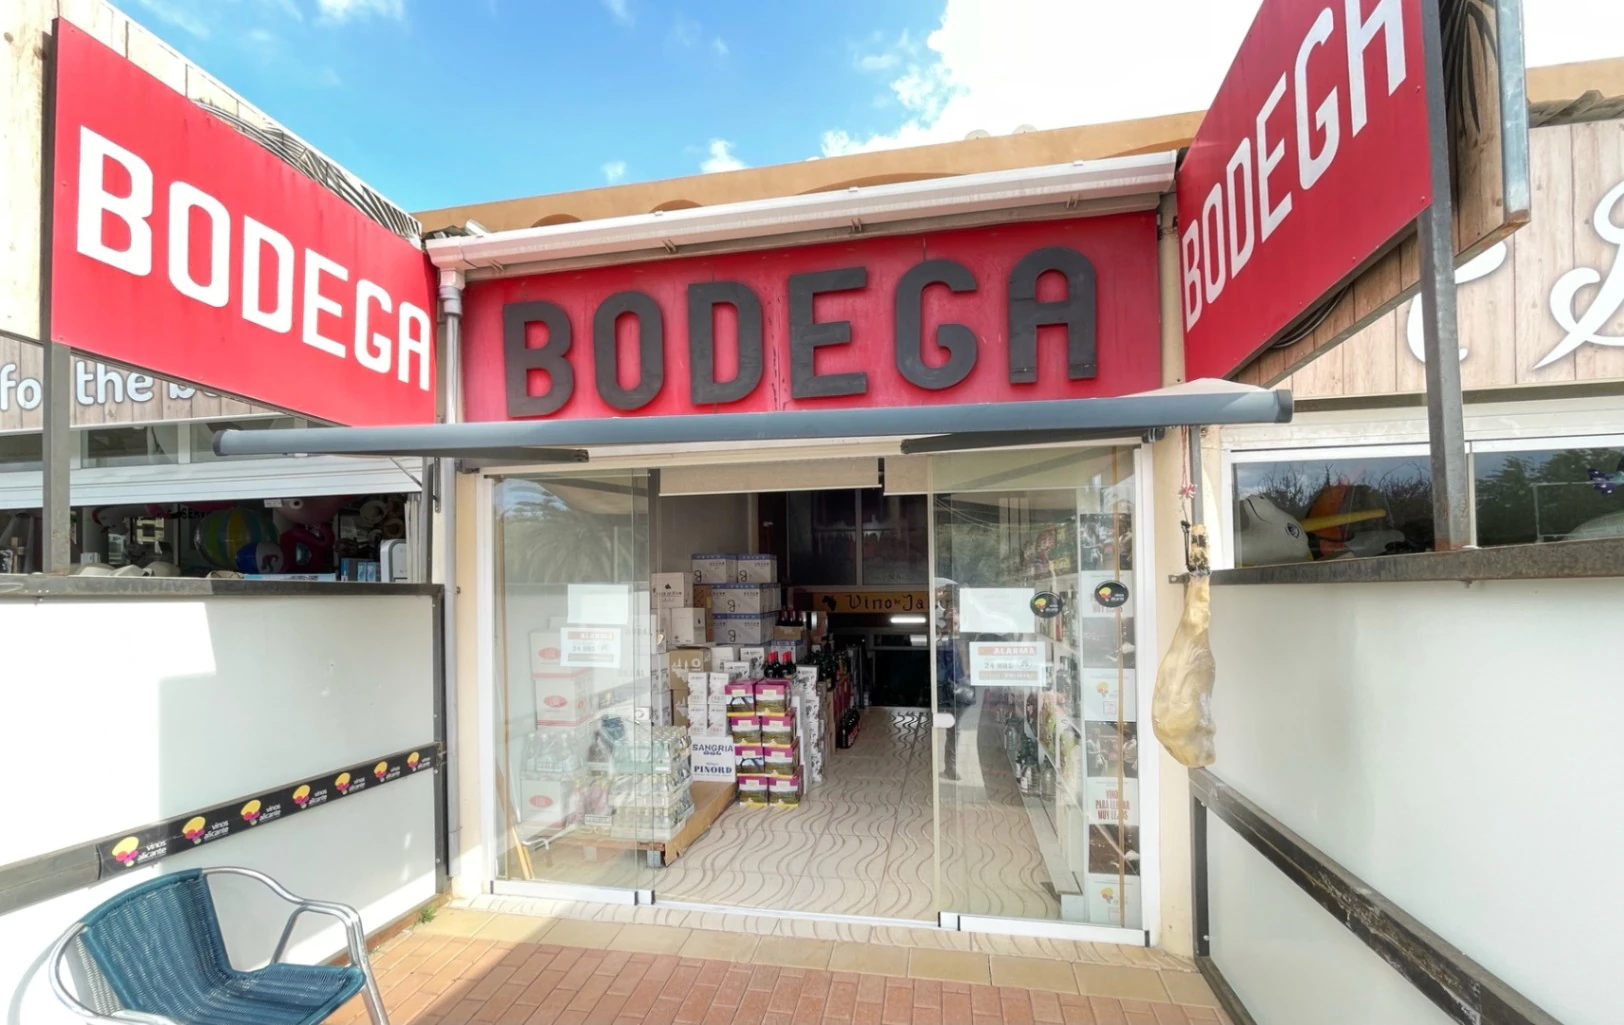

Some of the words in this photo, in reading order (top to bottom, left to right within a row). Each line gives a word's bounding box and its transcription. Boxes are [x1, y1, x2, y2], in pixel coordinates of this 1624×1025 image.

[76, 124, 430, 391] BODEGA
[502, 246, 1098, 418] BODEGA
[75, 361, 154, 406] the
[902, 593, 930, 612] Ja
[993, 647, 1036, 655] ALARMA
[692, 743, 734, 752] SANGRIA
[694, 765, 732, 774] PINORD
[314, 789, 328, 797] vinos
[265, 803, 281, 813] vinos
[258, 809, 282, 821] alicante
[211, 819, 229, 831] vinos
[203, 826, 229, 839] alicante
[146, 839, 167, 851] vinos
[137, 847, 167, 862] alicante
